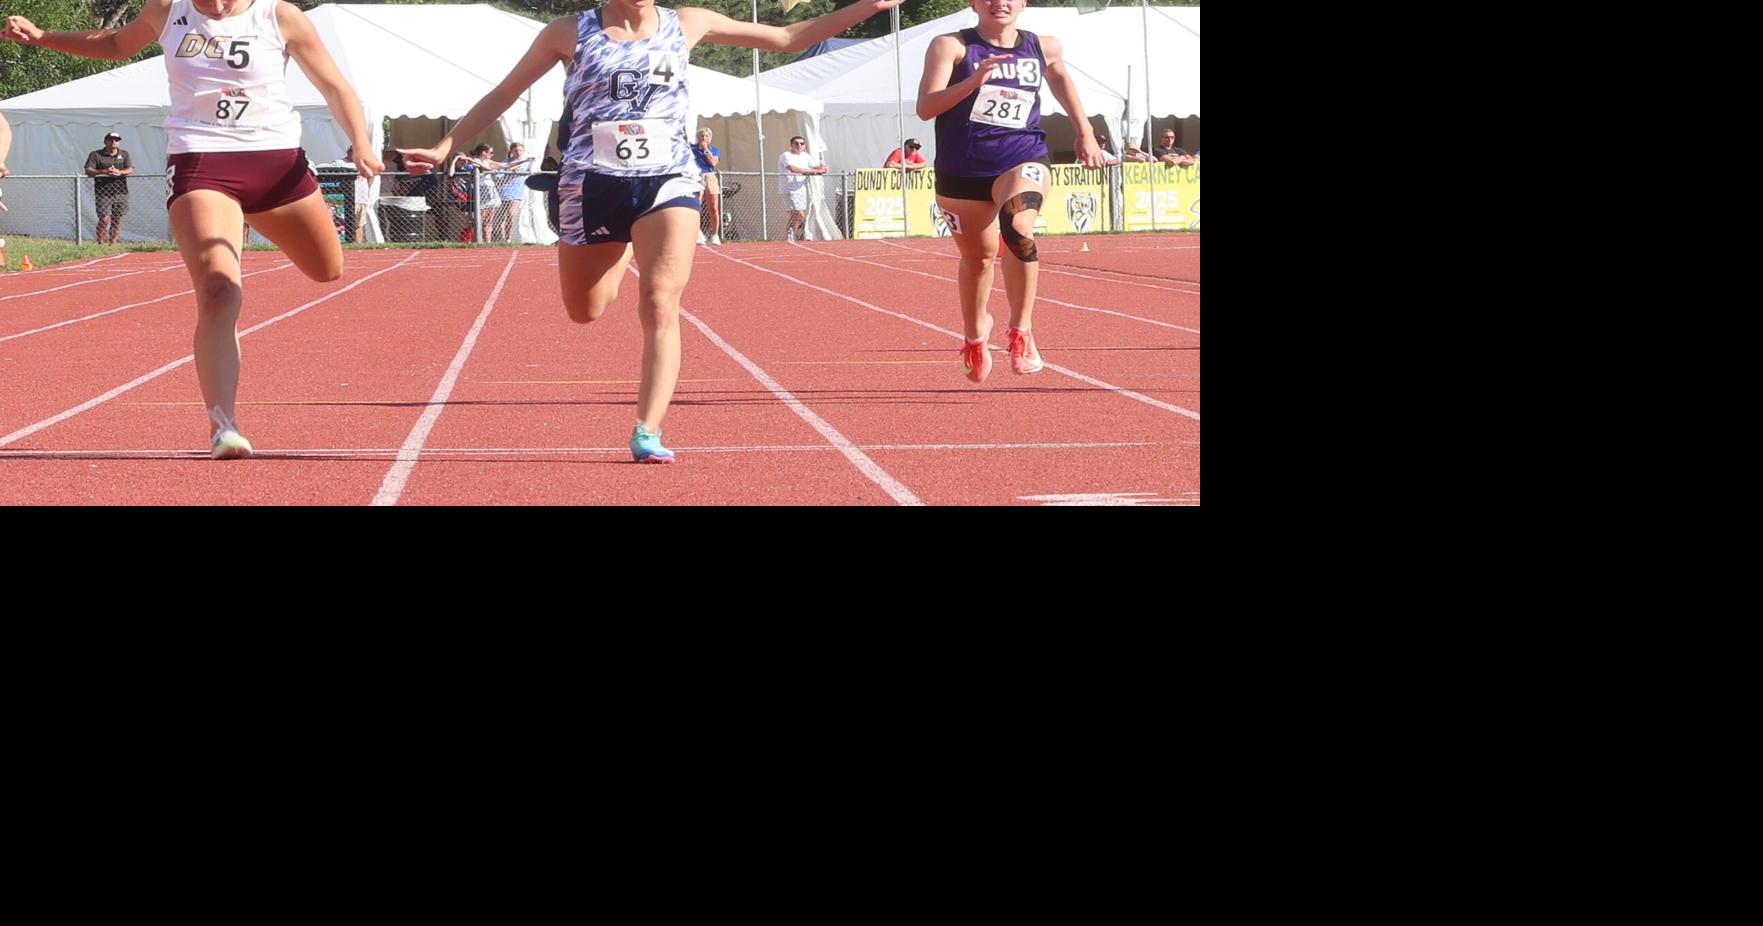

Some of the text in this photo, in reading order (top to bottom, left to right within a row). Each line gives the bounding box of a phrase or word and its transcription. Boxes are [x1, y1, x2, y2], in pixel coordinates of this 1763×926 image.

[175, 33, 258, 59] DC
[226, 40, 250, 69] 5
[653, 54, 674, 83] 4
[1022, 60, 1037, 84] 3
[215, 99, 250, 120] 87
[982, 99, 1021, 121] 281
[615, 138, 650, 160] 63
[857, 170, 888, 191] DUNDY
[1025, 165, 1041, 182] 3
[1124, 164, 1182, 185] KEARNEY
[943, 211, 958, 231] 3
